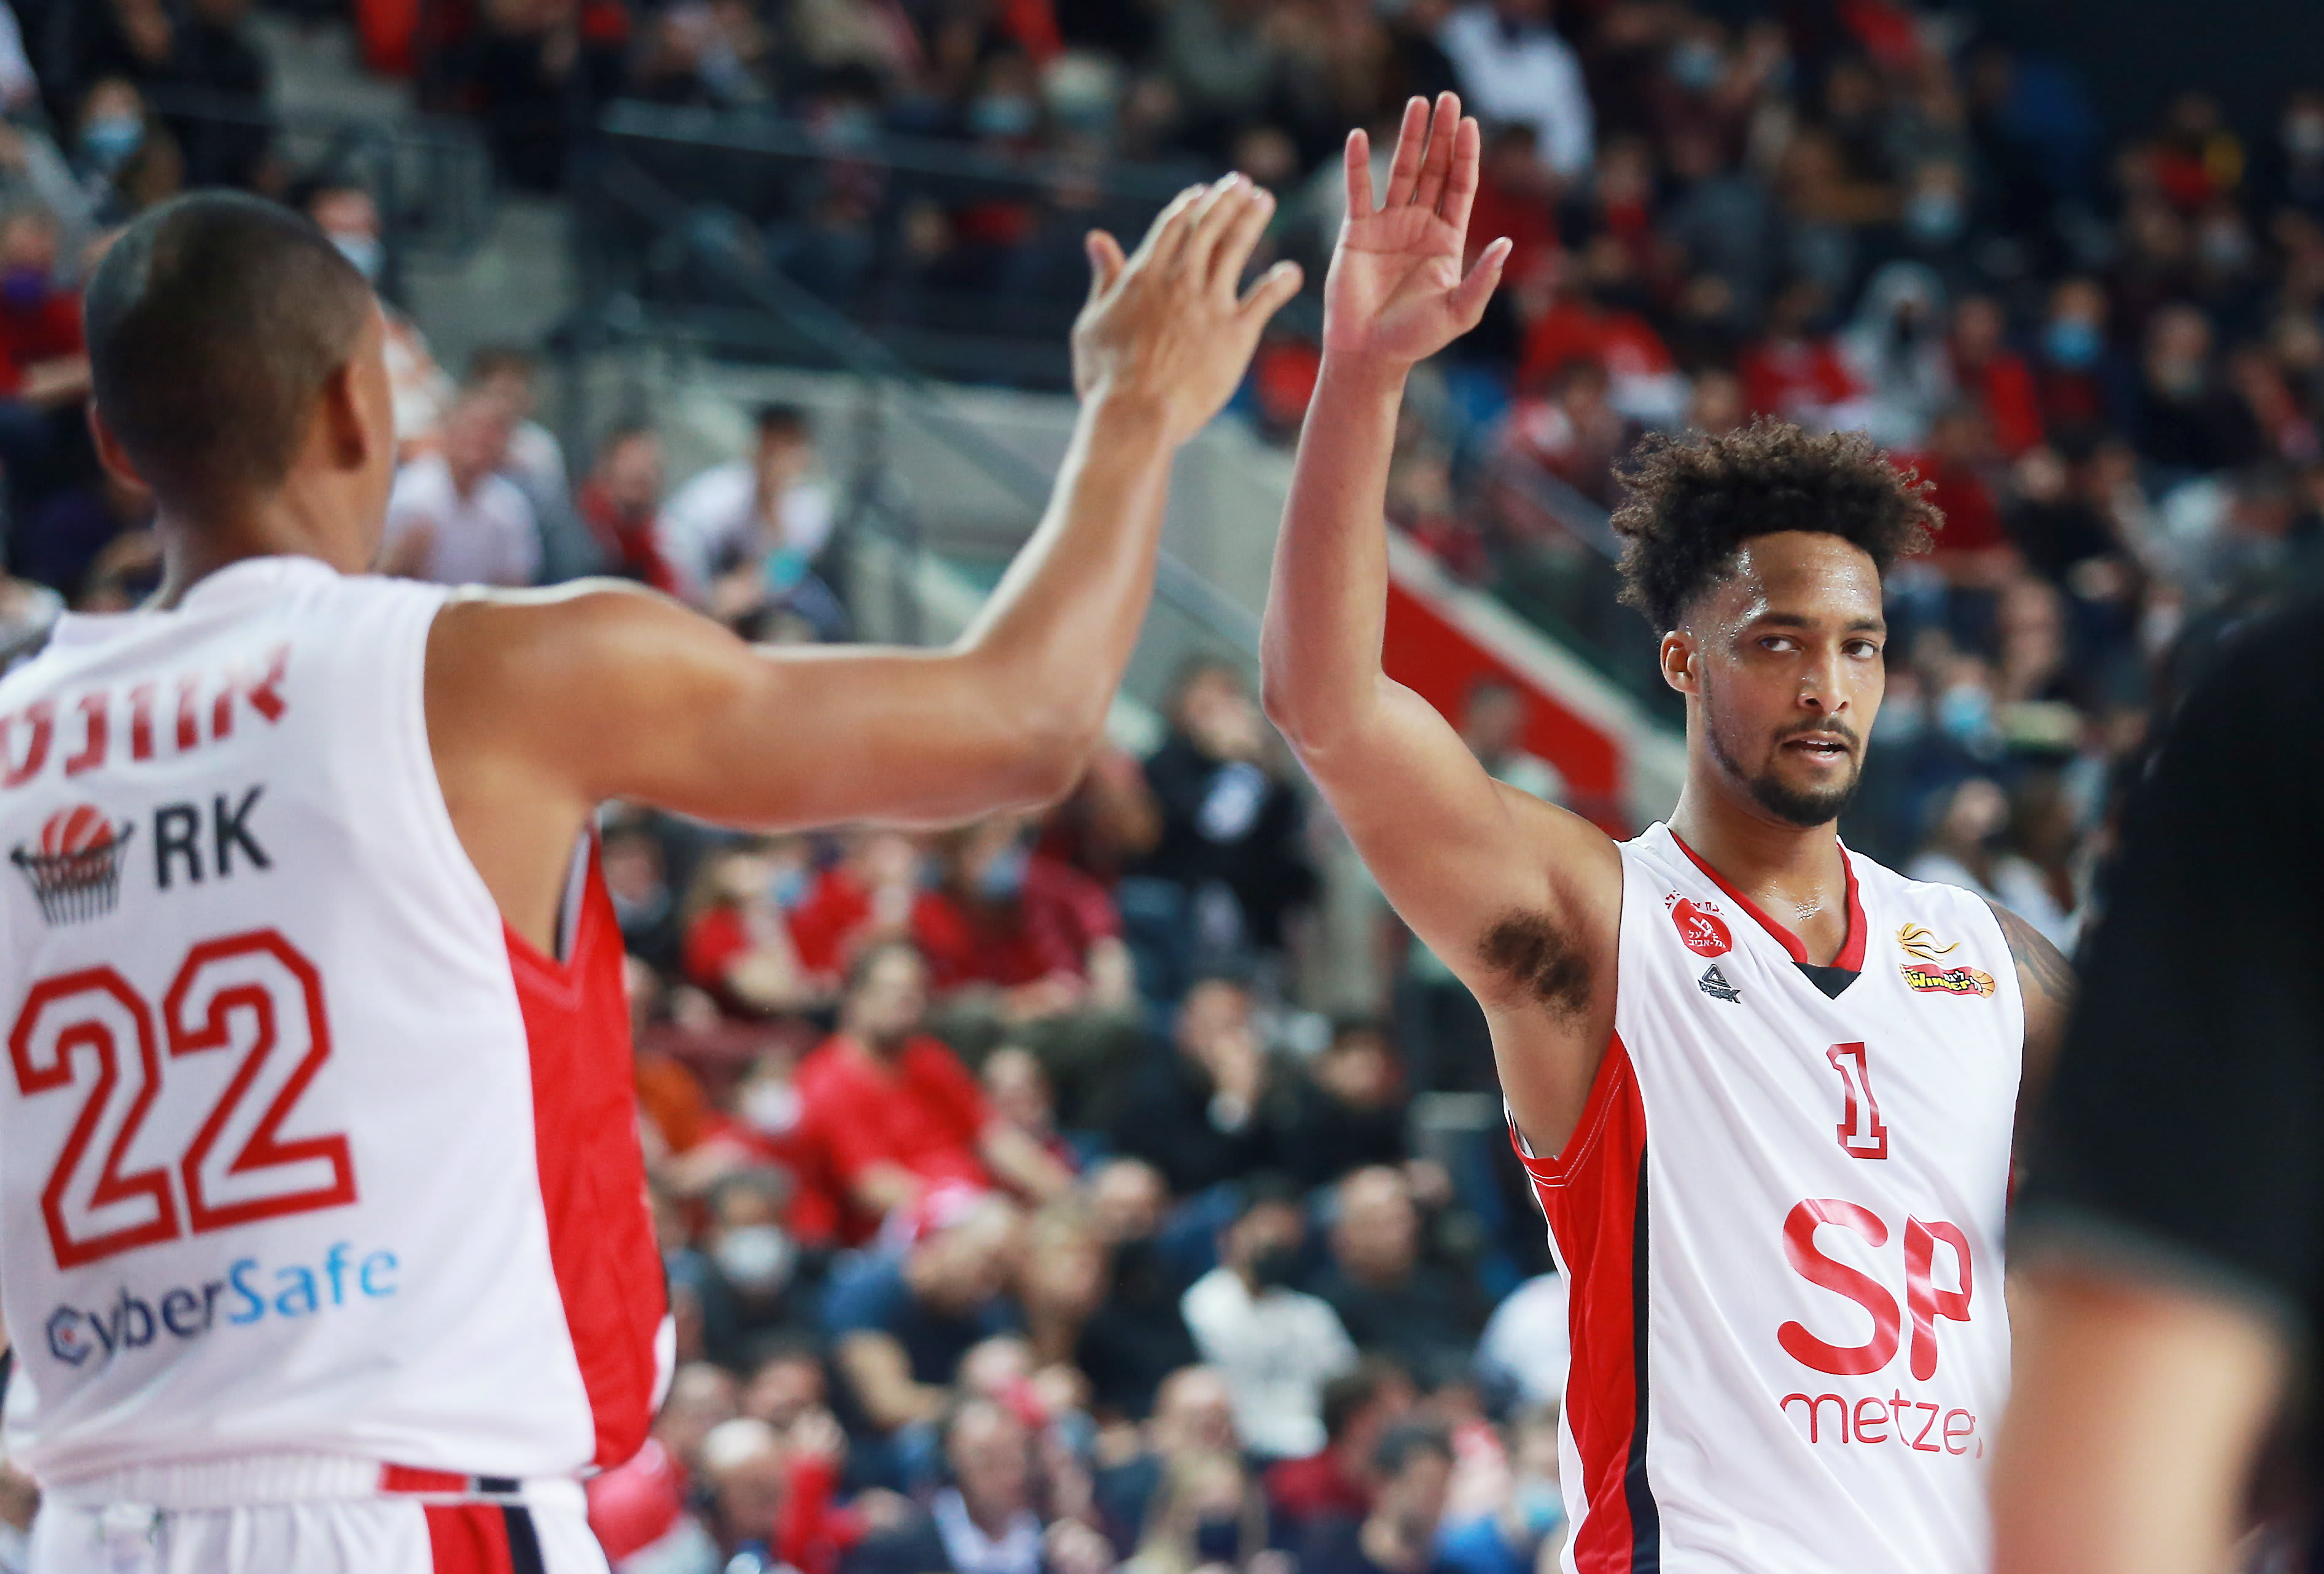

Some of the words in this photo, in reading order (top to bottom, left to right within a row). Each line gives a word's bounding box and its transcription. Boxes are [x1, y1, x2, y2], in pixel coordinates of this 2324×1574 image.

[152, 785, 271, 892] RK
[8, 927, 359, 1271] 22
[1827, 1042, 1888, 1159] 1
[45, 1240, 399, 1367] CyberSafe
[1777, 1198, 1972, 1381] SP
